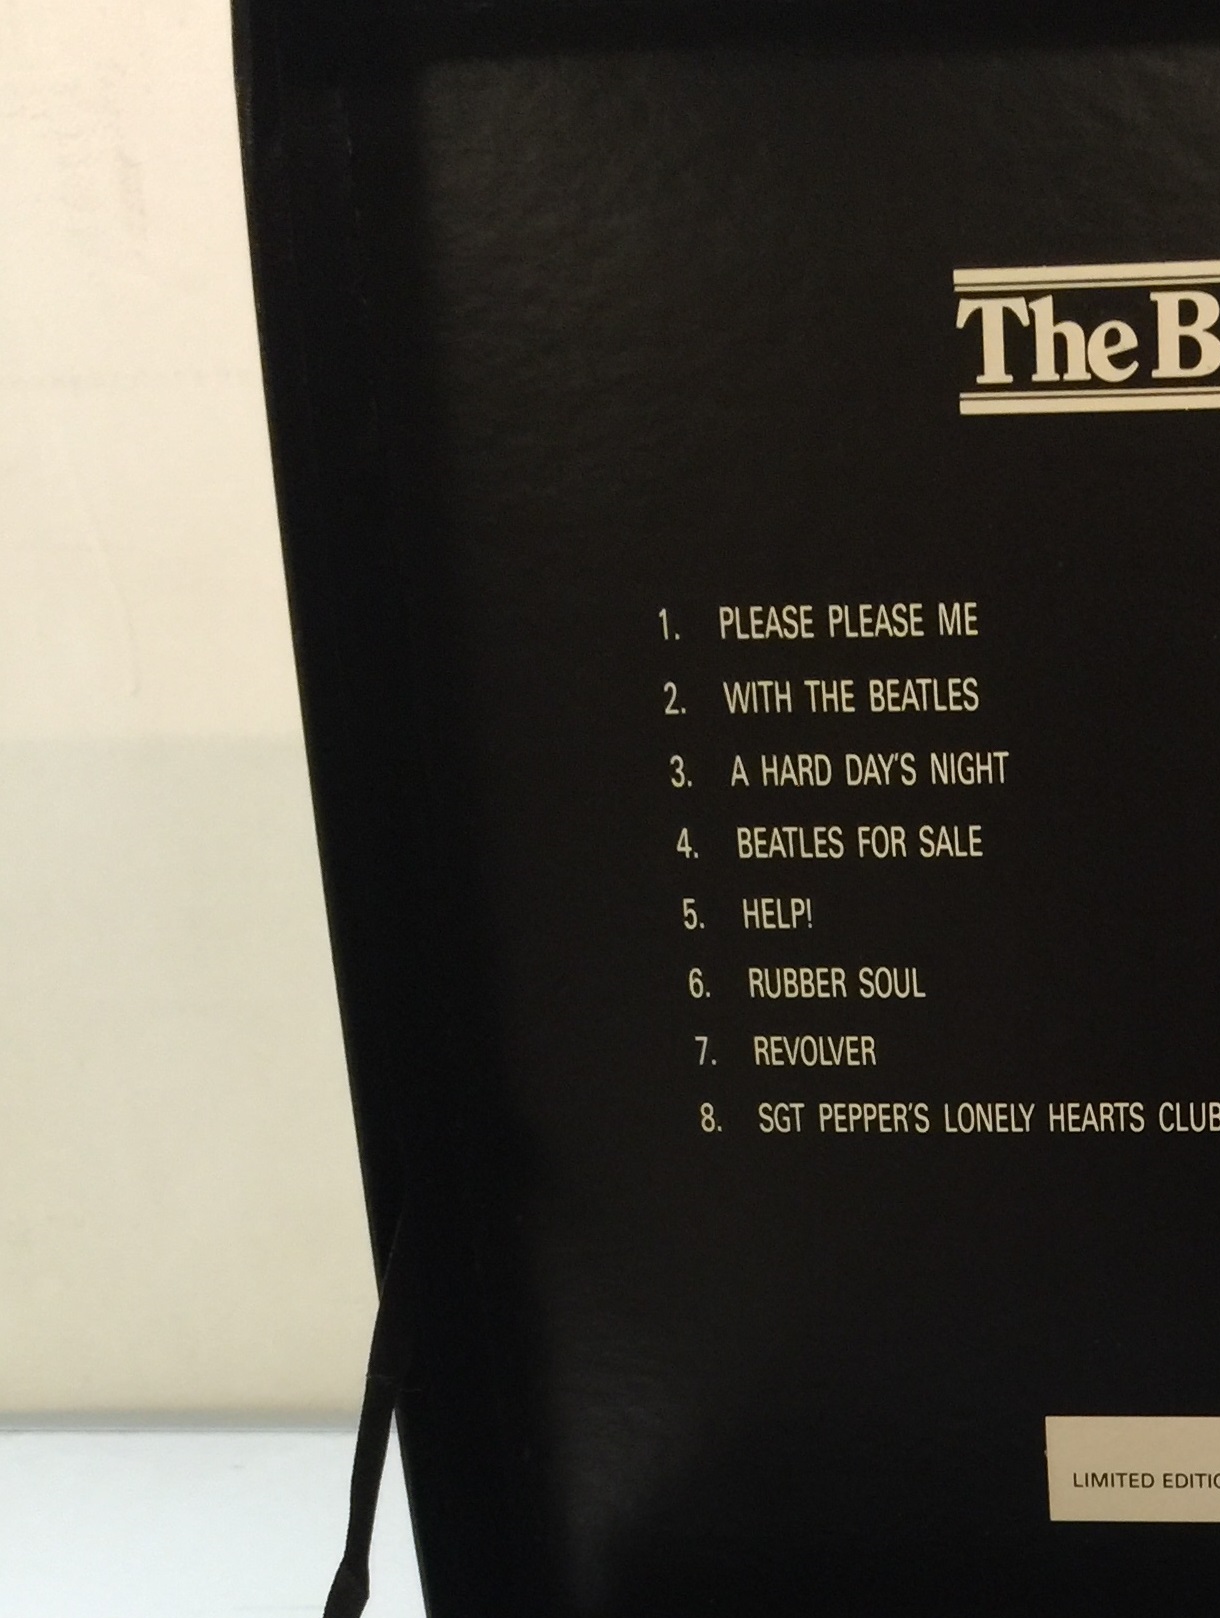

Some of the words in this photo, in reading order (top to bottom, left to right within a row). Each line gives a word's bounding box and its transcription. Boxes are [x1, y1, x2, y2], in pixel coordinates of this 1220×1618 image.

[956, 294, 1139, 384] The
[658, 608, 680, 640] 1.
[719, 604, 815, 640] PLEASE
[828, 602, 925, 638] PLEASE
[938, 601, 979, 636] ME
[663, 681, 687, 715] 2.
[722, 680, 792, 714] WITH
[803, 679, 856, 713] THE
[869, 677, 979, 712] BEATLES
[669, 754, 693, 788] 3.
[731, 754, 750, 787] A
[761, 753, 832, 787] HARD
[845, 752, 917, 786] DAY'S
[930, 751, 1010, 785] NIGHT
[676, 827, 699, 859] 4.
[736, 825, 845, 859] BEATLES
[857, 825, 907, 859] FOR
[918, 824, 984, 858] SALE
[682, 898, 705, 930] 5.
[742, 897, 813, 929] HELP!
[688, 967, 711, 999] 6.
[748, 967, 847, 999] RUBBER
[858, 966, 927, 999] SOUL
[694, 1035, 717, 1066] 7.
[753, 1035, 877, 1067] REVOLVER
[700, 1102, 723, 1133] 8.
[758, 1102, 805, 1133] SGT
[818, 1102, 930, 1134] PEPPER'S
[944, 1102, 1035, 1134] LONELY
[1048, 1101, 1145, 1133] HEARTS
[1073, 1472, 1155, 1489] LIMITED
